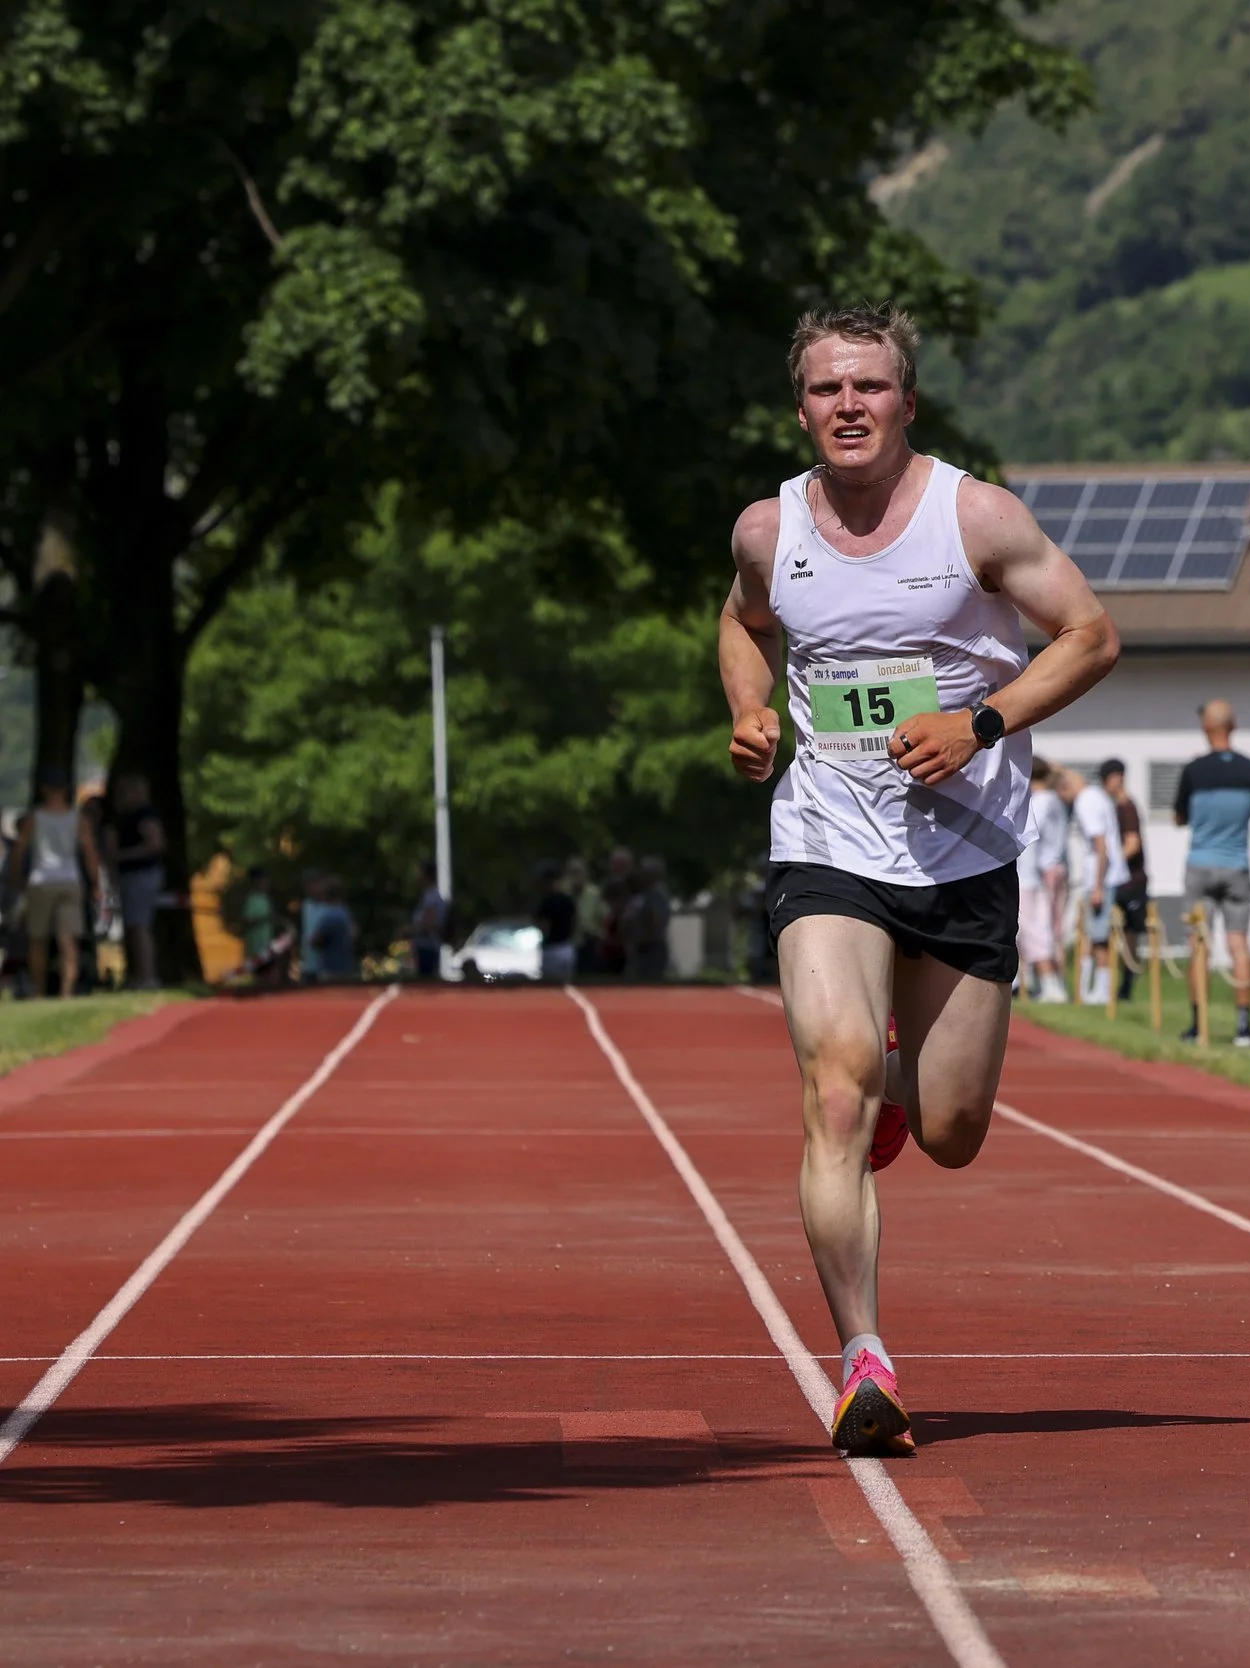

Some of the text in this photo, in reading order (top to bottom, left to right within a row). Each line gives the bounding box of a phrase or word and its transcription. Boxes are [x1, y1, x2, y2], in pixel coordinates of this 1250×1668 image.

[791, 571, 813, 580] erima
[814, 668, 859, 680] stv gampel
[877, 660, 921, 676] lonzalauf
[843, 686, 895, 727] 15
[818, 742, 857, 751] RAIFFEISEN
